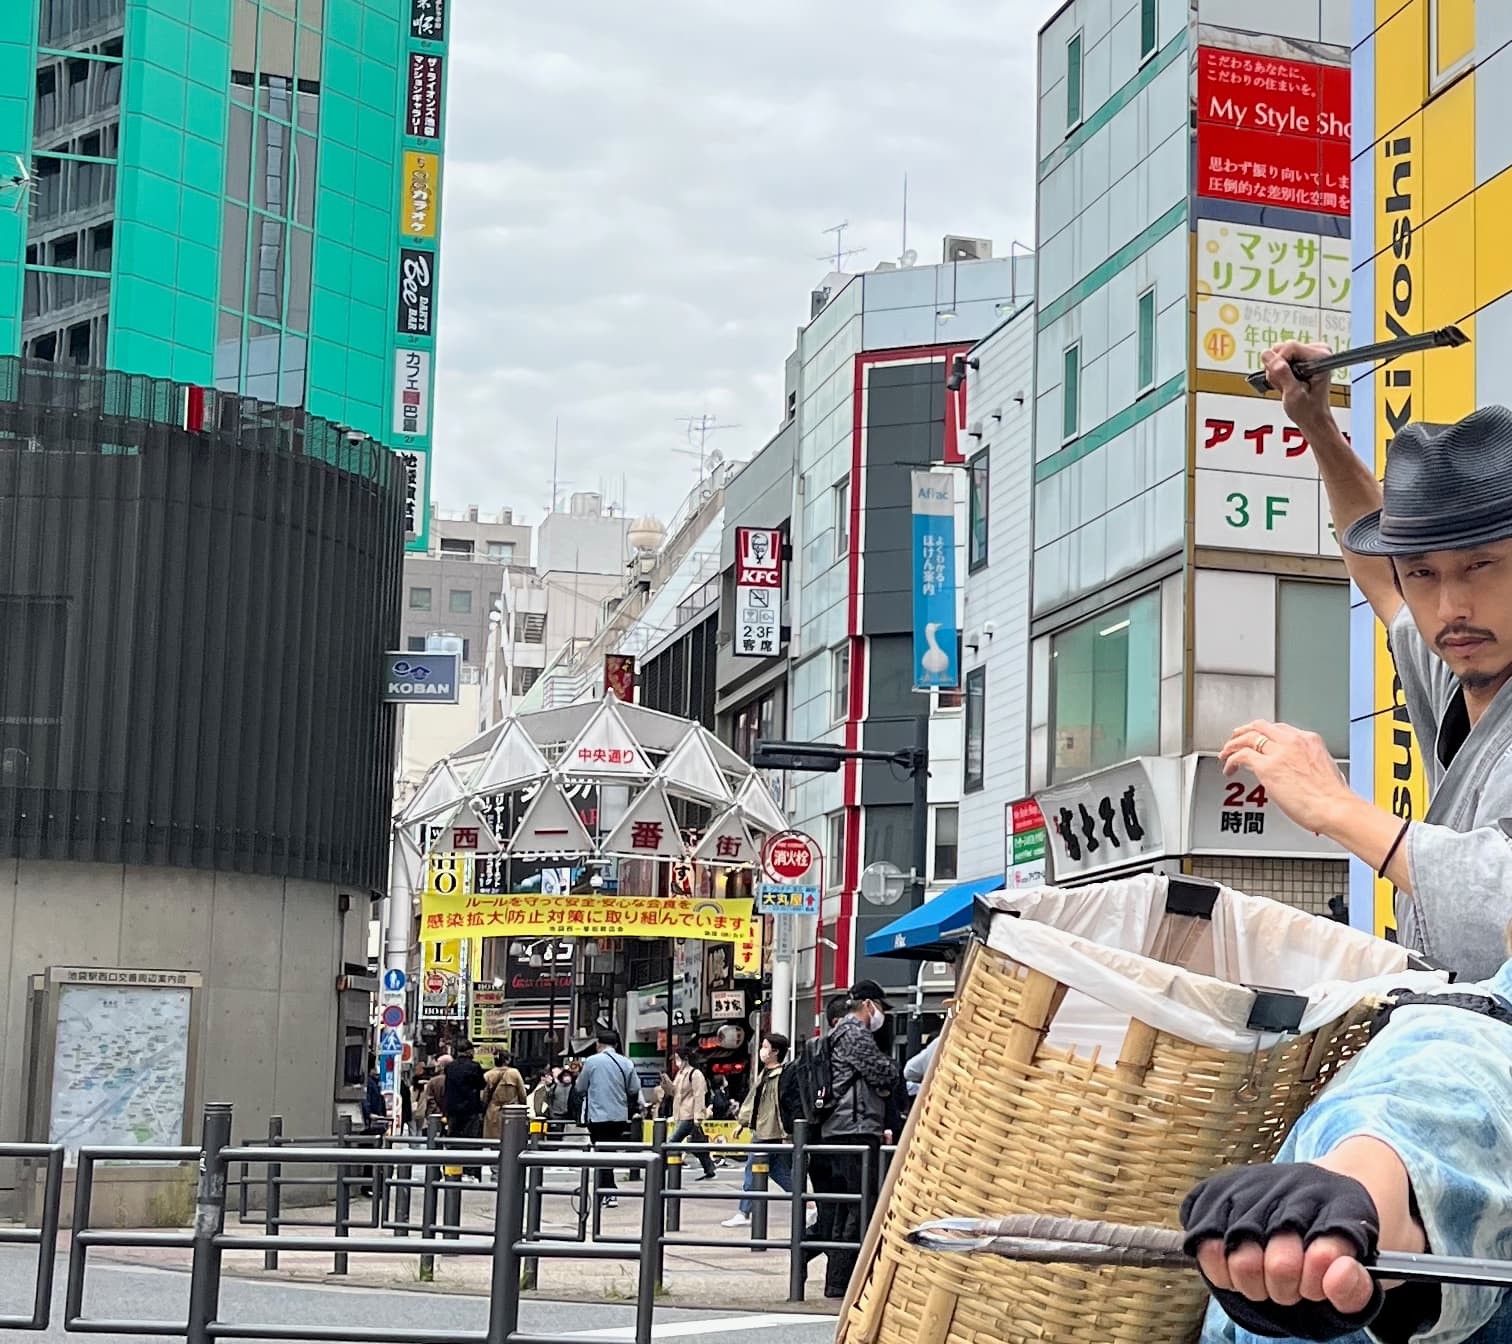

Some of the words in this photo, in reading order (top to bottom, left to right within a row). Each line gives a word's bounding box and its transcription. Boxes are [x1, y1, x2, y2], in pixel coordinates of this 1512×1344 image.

[1207, 54, 1307, 81] こだわるあなたに、
[1207, 69, 1317, 98] こだわりの住まいを。
[1209, 95, 1248, 130] My
[1254, 102, 1310, 136] Style
[1208, 177, 1351, 211] 圧倒的な差別化空間を
[403, 255, 430, 306] Bee
[407, 307, 418, 331] BAR
[418, 296, 429, 332] DARTS
[1207, 333, 1231, 355] 4F
[740, 570, 779, 585] KFC
[743, 641, 773, 652] 客席
[388, 682, 450, 694] KOBAN
[579, 747, 635, 764] 中央通り
[1223, 782, 1269, 807] 24
[1220, 810, 1265, 836] 時間
[774, 850, 809, 867] 消火栓
[427, 909, 745, 930] 感染拡大防止対策に取り組んでいます
